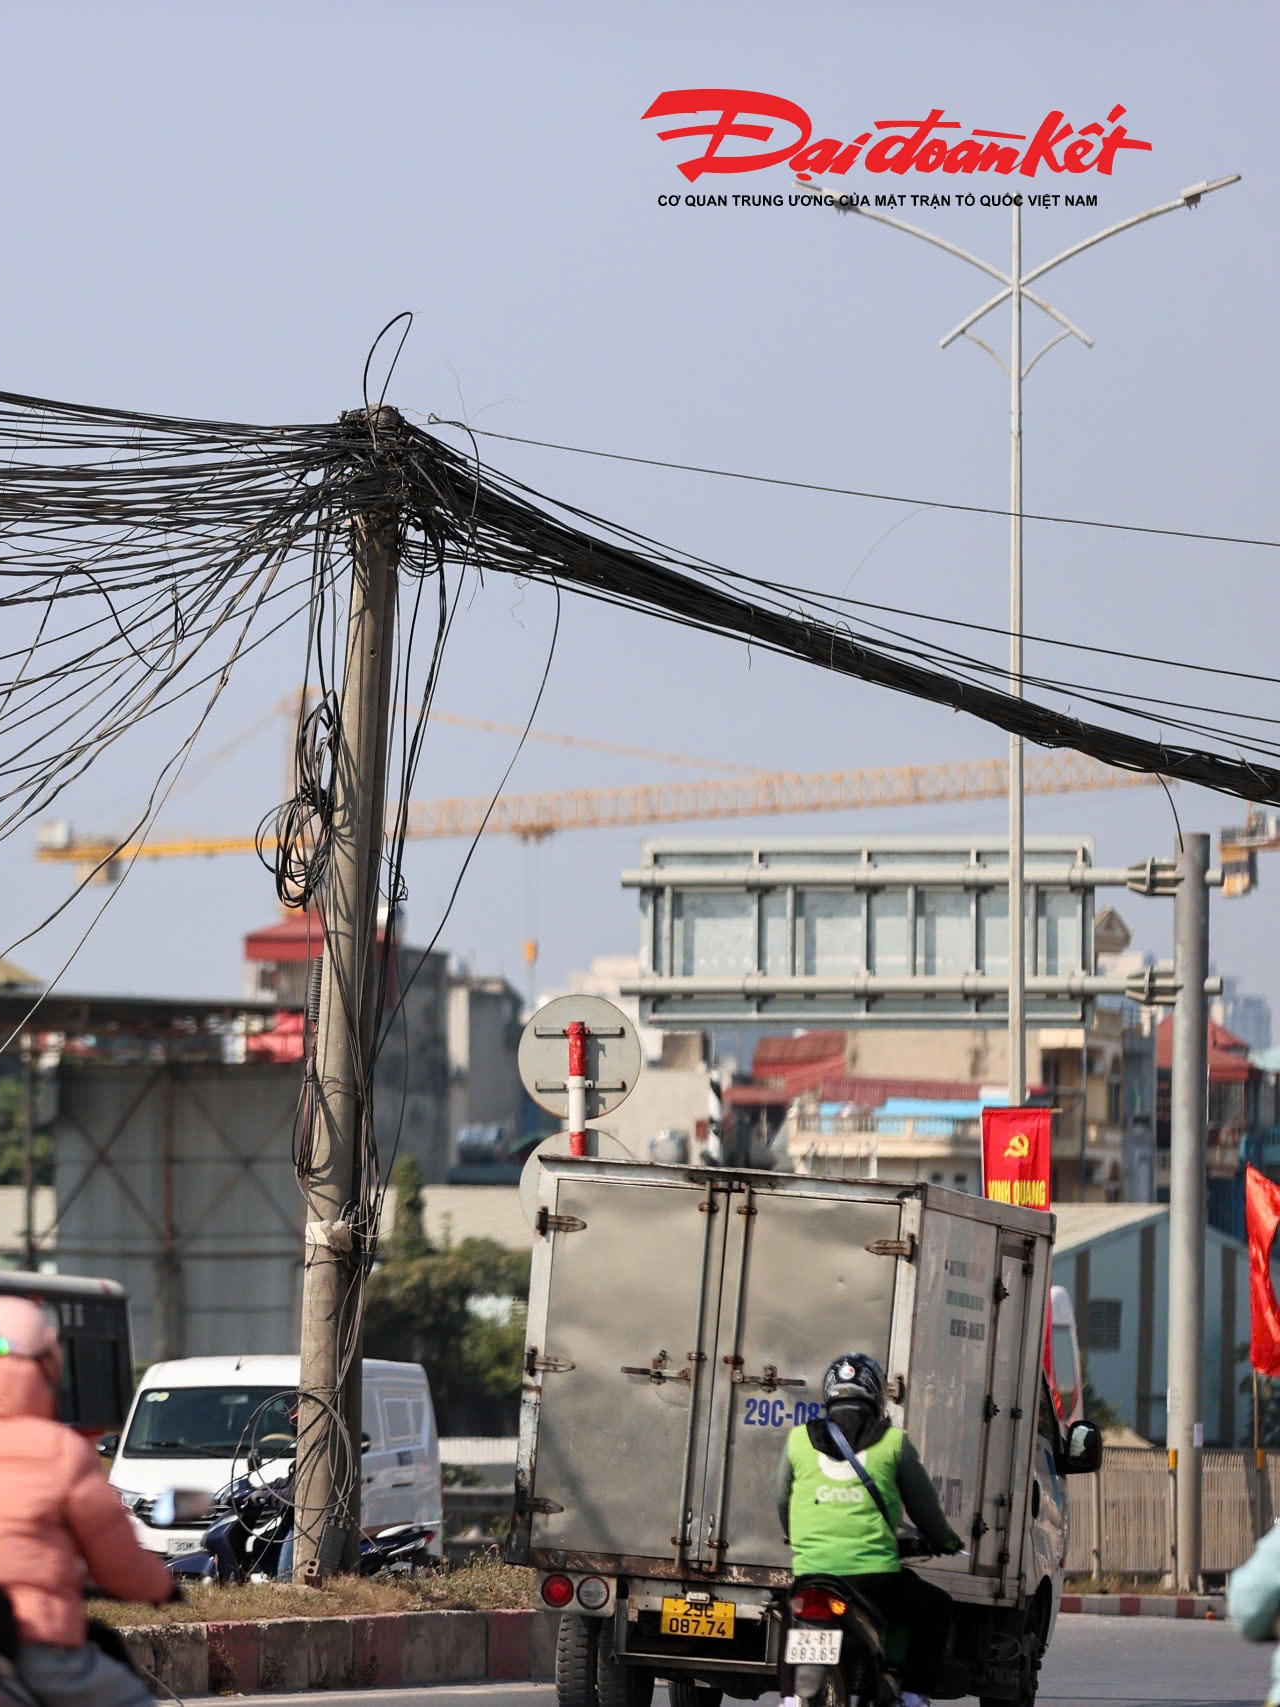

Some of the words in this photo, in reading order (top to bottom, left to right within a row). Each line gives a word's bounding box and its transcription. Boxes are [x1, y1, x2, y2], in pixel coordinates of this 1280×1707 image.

[1013, 1180, 1046, 1207] QUANG
[743, 1398, 827, 1428] 29C-08
[683, 1600, 715, 1618] 29C
[669, 1617, 727, 1637] 087.74
